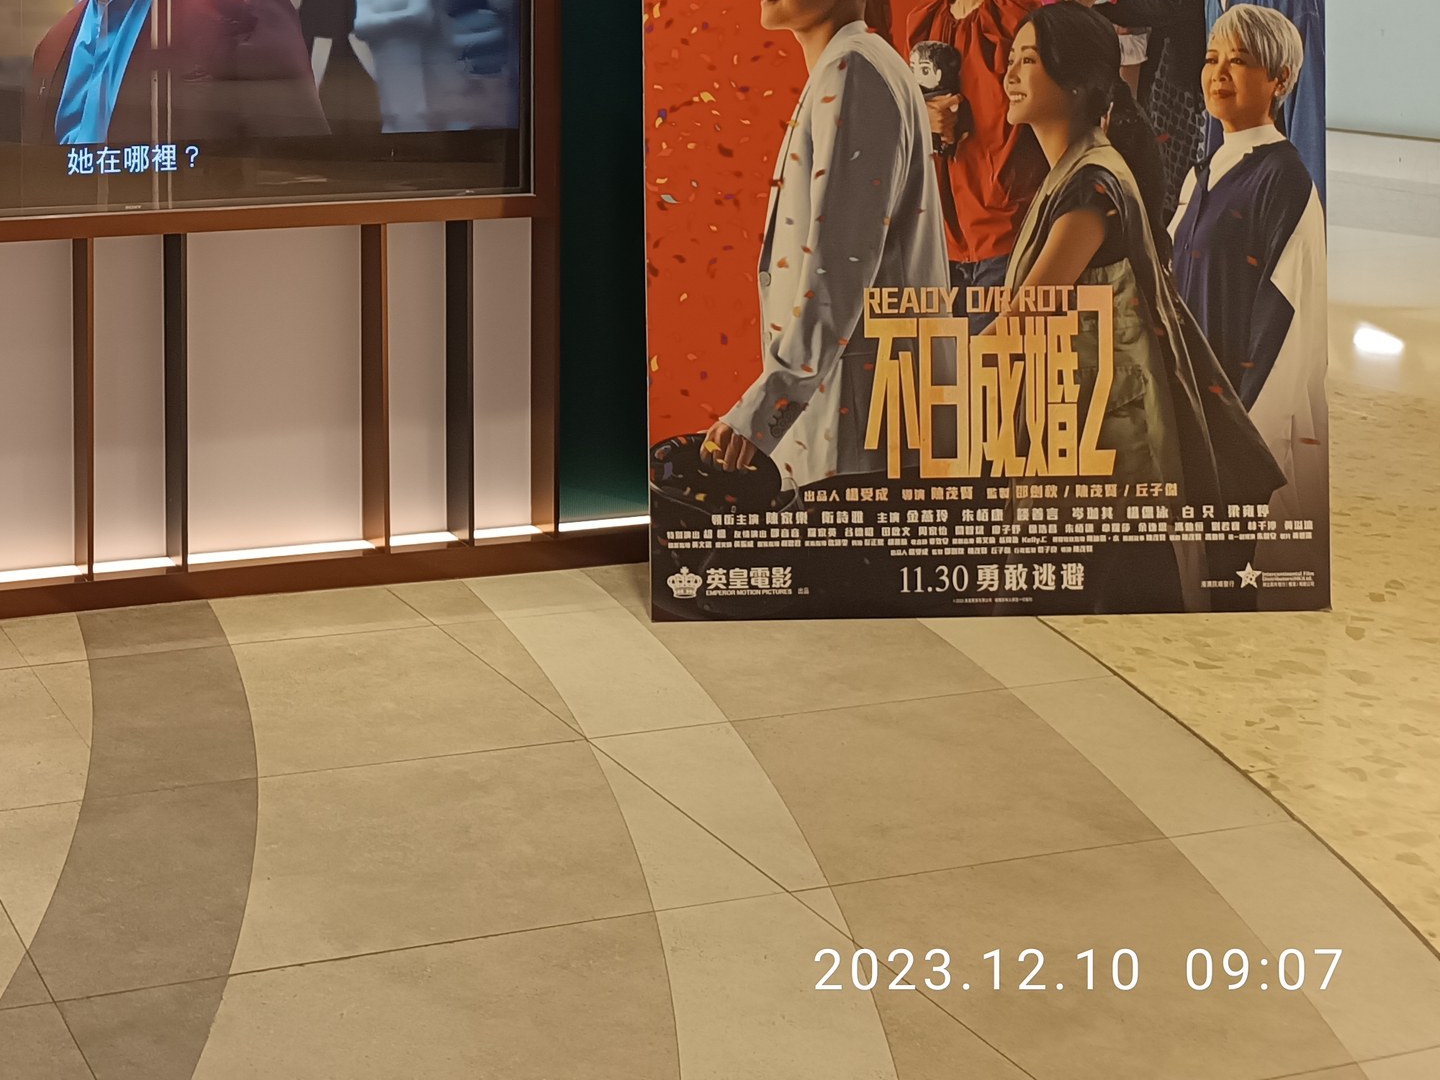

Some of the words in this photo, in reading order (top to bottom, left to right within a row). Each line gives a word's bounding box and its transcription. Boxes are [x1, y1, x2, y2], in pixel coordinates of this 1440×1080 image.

[864, 287, 959, 314] READY
[1019, 285, 1075, 312] ROT
[706, 566, 792, 589] 英皇電影
[900, 565, 969, 593] 11.30
[976, 563, 1085, 592] 勇敢逃避
